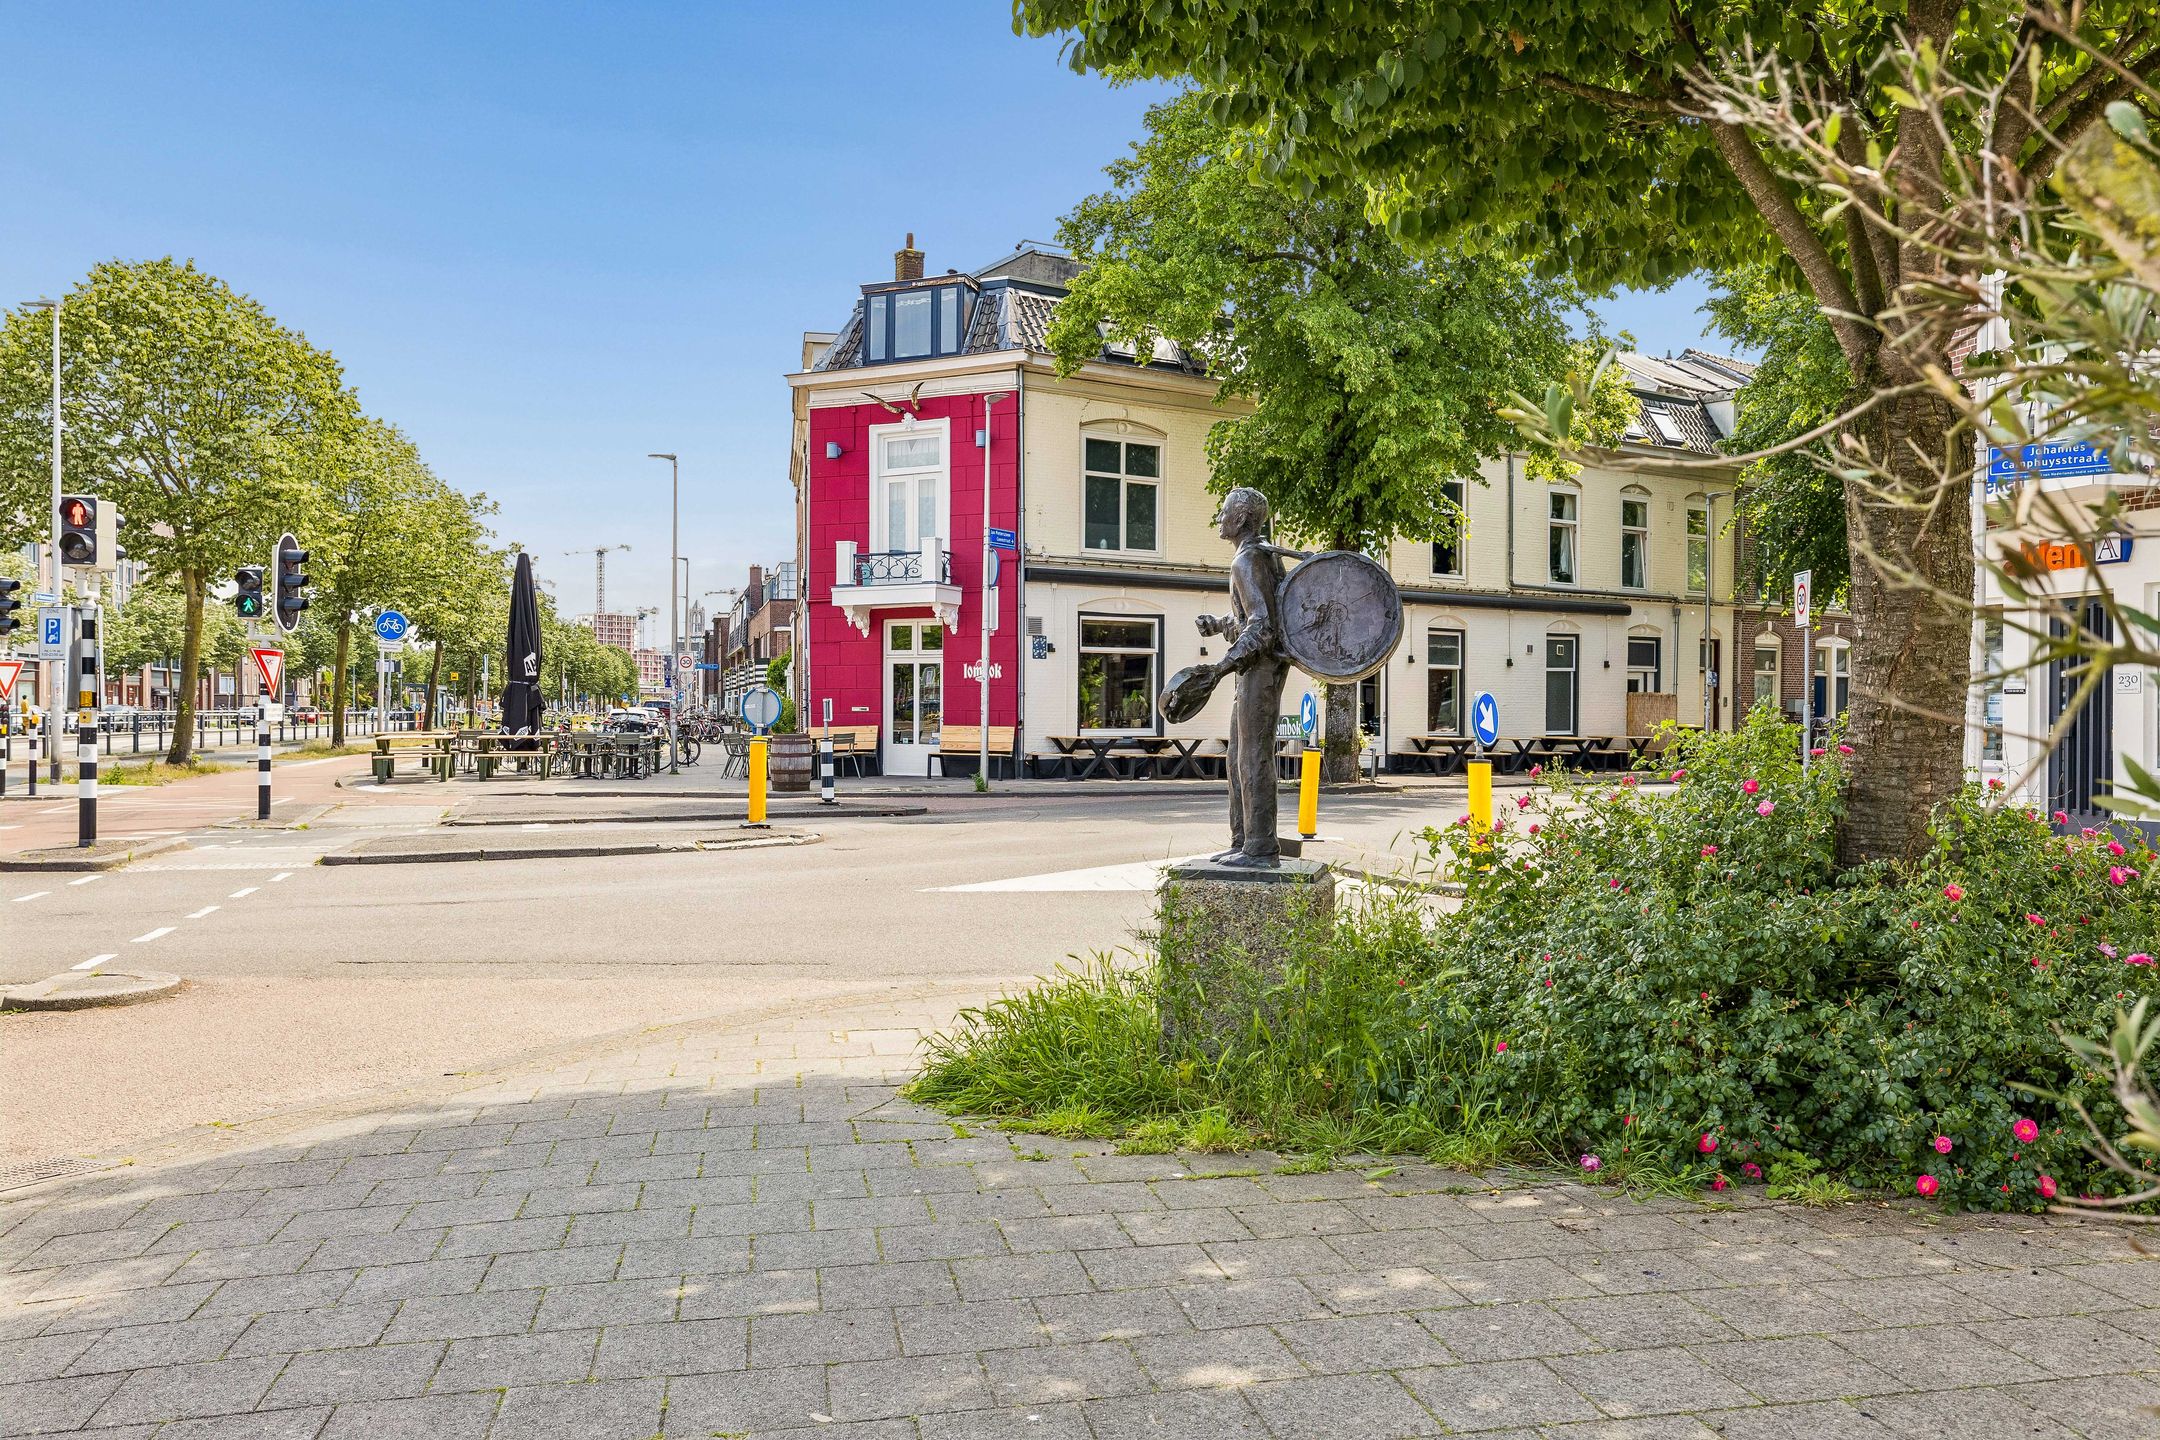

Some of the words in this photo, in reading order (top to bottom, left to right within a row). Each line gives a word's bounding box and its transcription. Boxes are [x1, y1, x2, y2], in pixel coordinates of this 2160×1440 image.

[2030, 444, 2086, 456] Johannes
[48, 619, 58, 634] P
[963, 661, 1002, 680] lomok
[2118, 675, 2139, 688] 230
